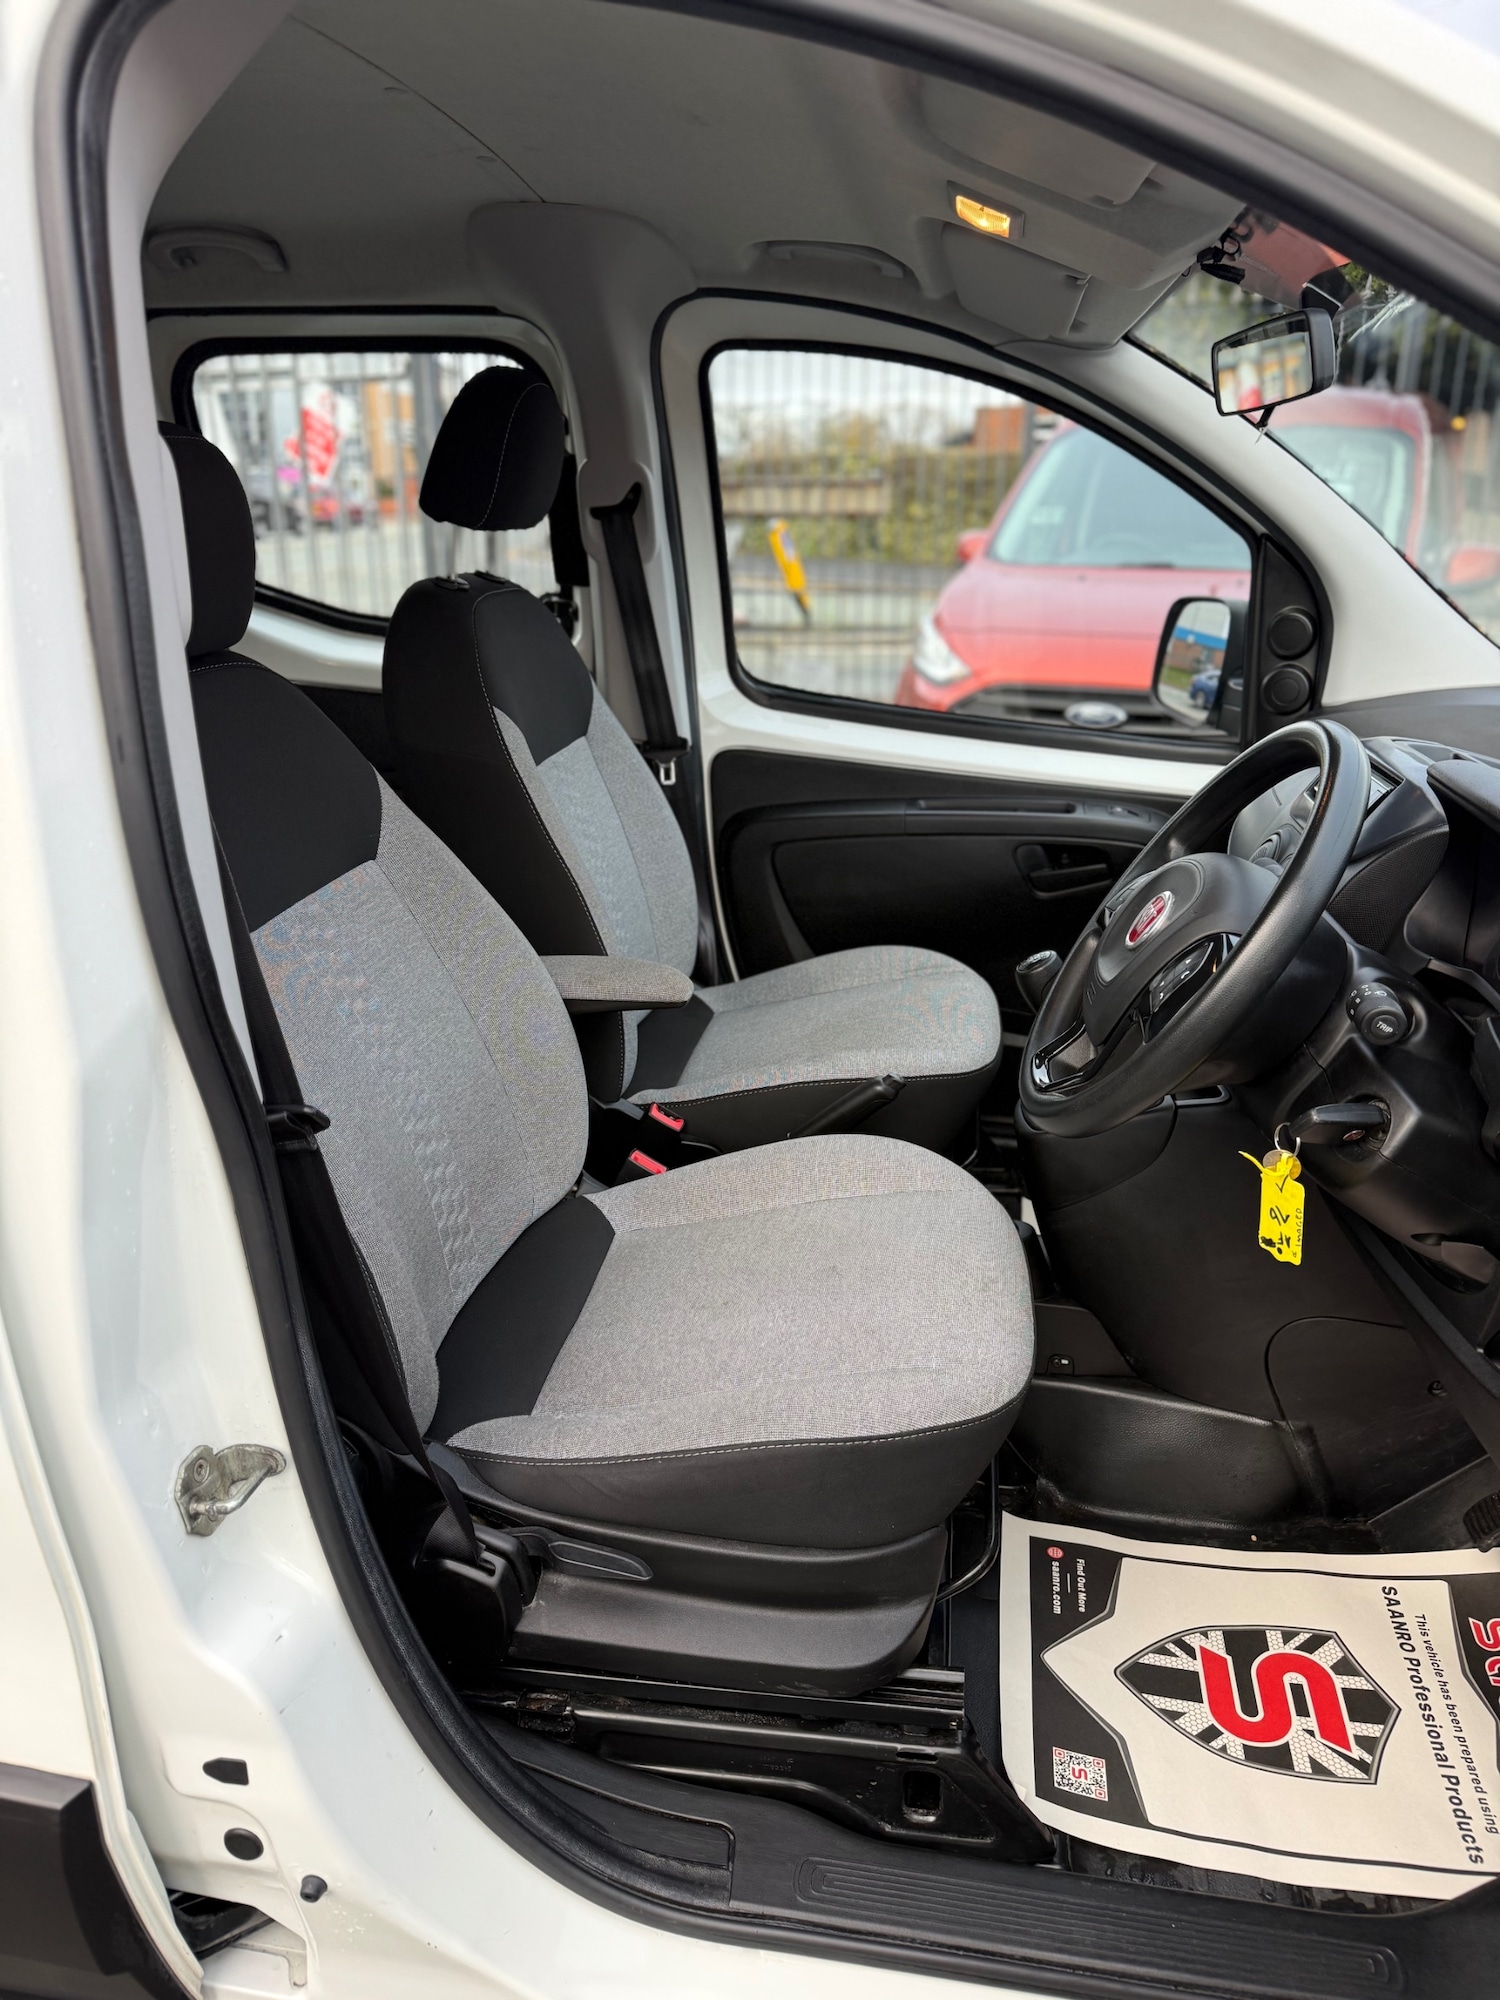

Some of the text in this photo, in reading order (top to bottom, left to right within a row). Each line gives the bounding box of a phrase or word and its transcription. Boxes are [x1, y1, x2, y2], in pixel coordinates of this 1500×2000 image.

[1376, 1021, 1394, 1033] TRIP
[1051, 1560, 1062, 1615] saanro.com
[1076, 1558, 1087, 1613] Find Out More
[1381, 1585, 1485, 1864] SAANRO Professional Products
[1414, 1613, 1500, 1834] This vehicle has been prepared using
